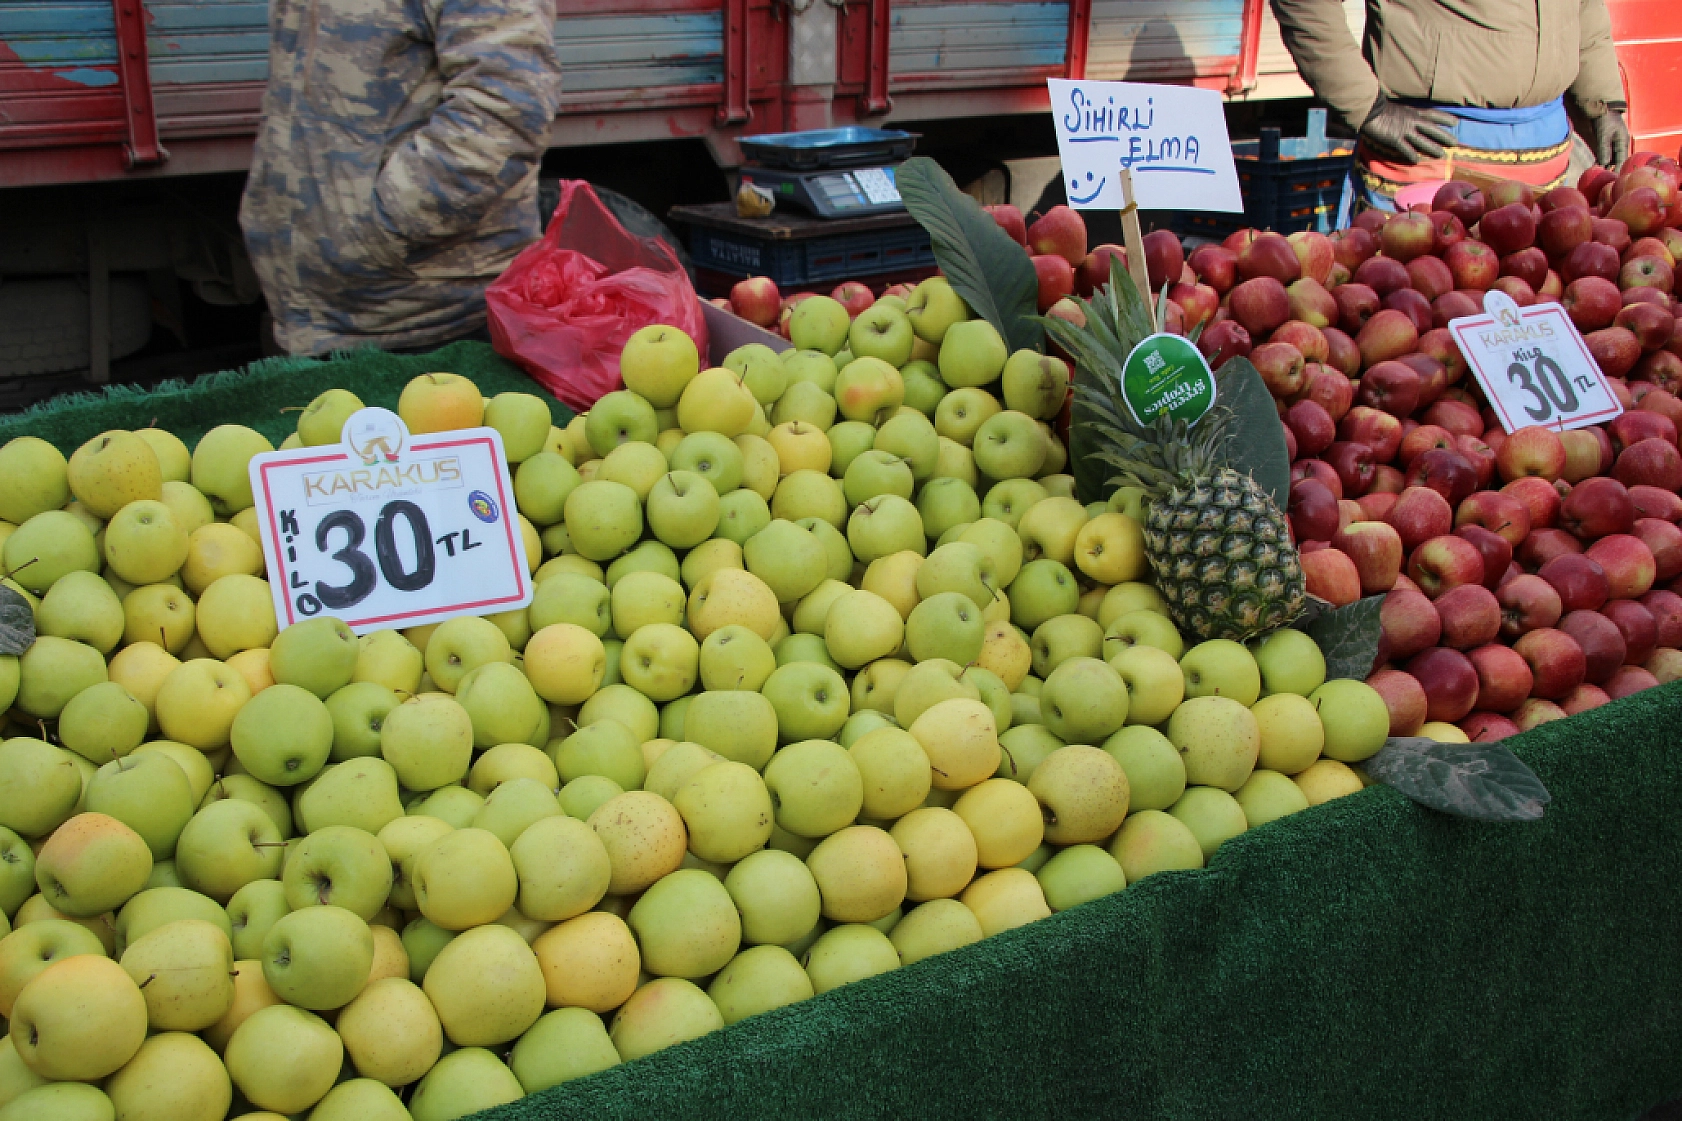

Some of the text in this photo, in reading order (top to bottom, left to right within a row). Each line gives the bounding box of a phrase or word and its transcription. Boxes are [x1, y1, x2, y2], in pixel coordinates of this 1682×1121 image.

[1120, 136, 1199, 168] ELMA
[1144, 381, 1191, 415] tropics
[1169, 378, 1205, 410] green
[1507, 356, 1596, 421] 30 TL
[315, 500, 436, 609] 30
[436, 529, 482, 556] TL
